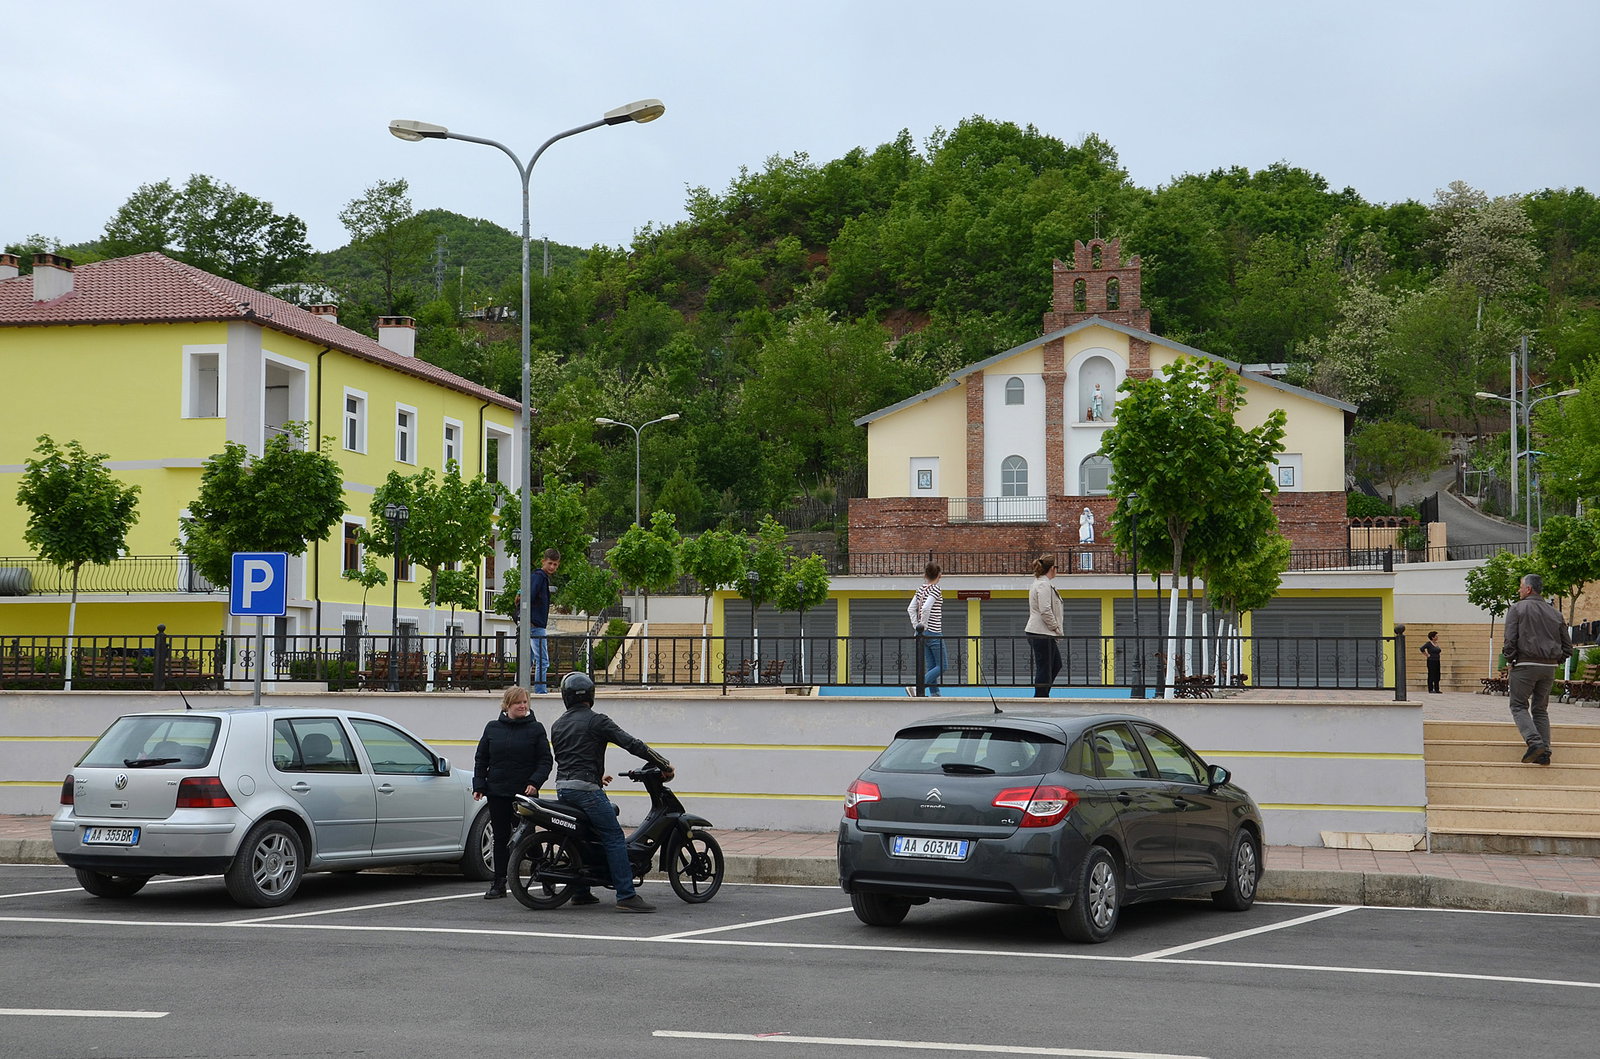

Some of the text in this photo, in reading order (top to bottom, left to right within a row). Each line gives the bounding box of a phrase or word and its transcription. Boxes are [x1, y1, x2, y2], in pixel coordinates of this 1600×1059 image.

[242, 559, 274, 609] P
[90, 829, 102, 841] AA
[903, 839, 916, 852] AA
